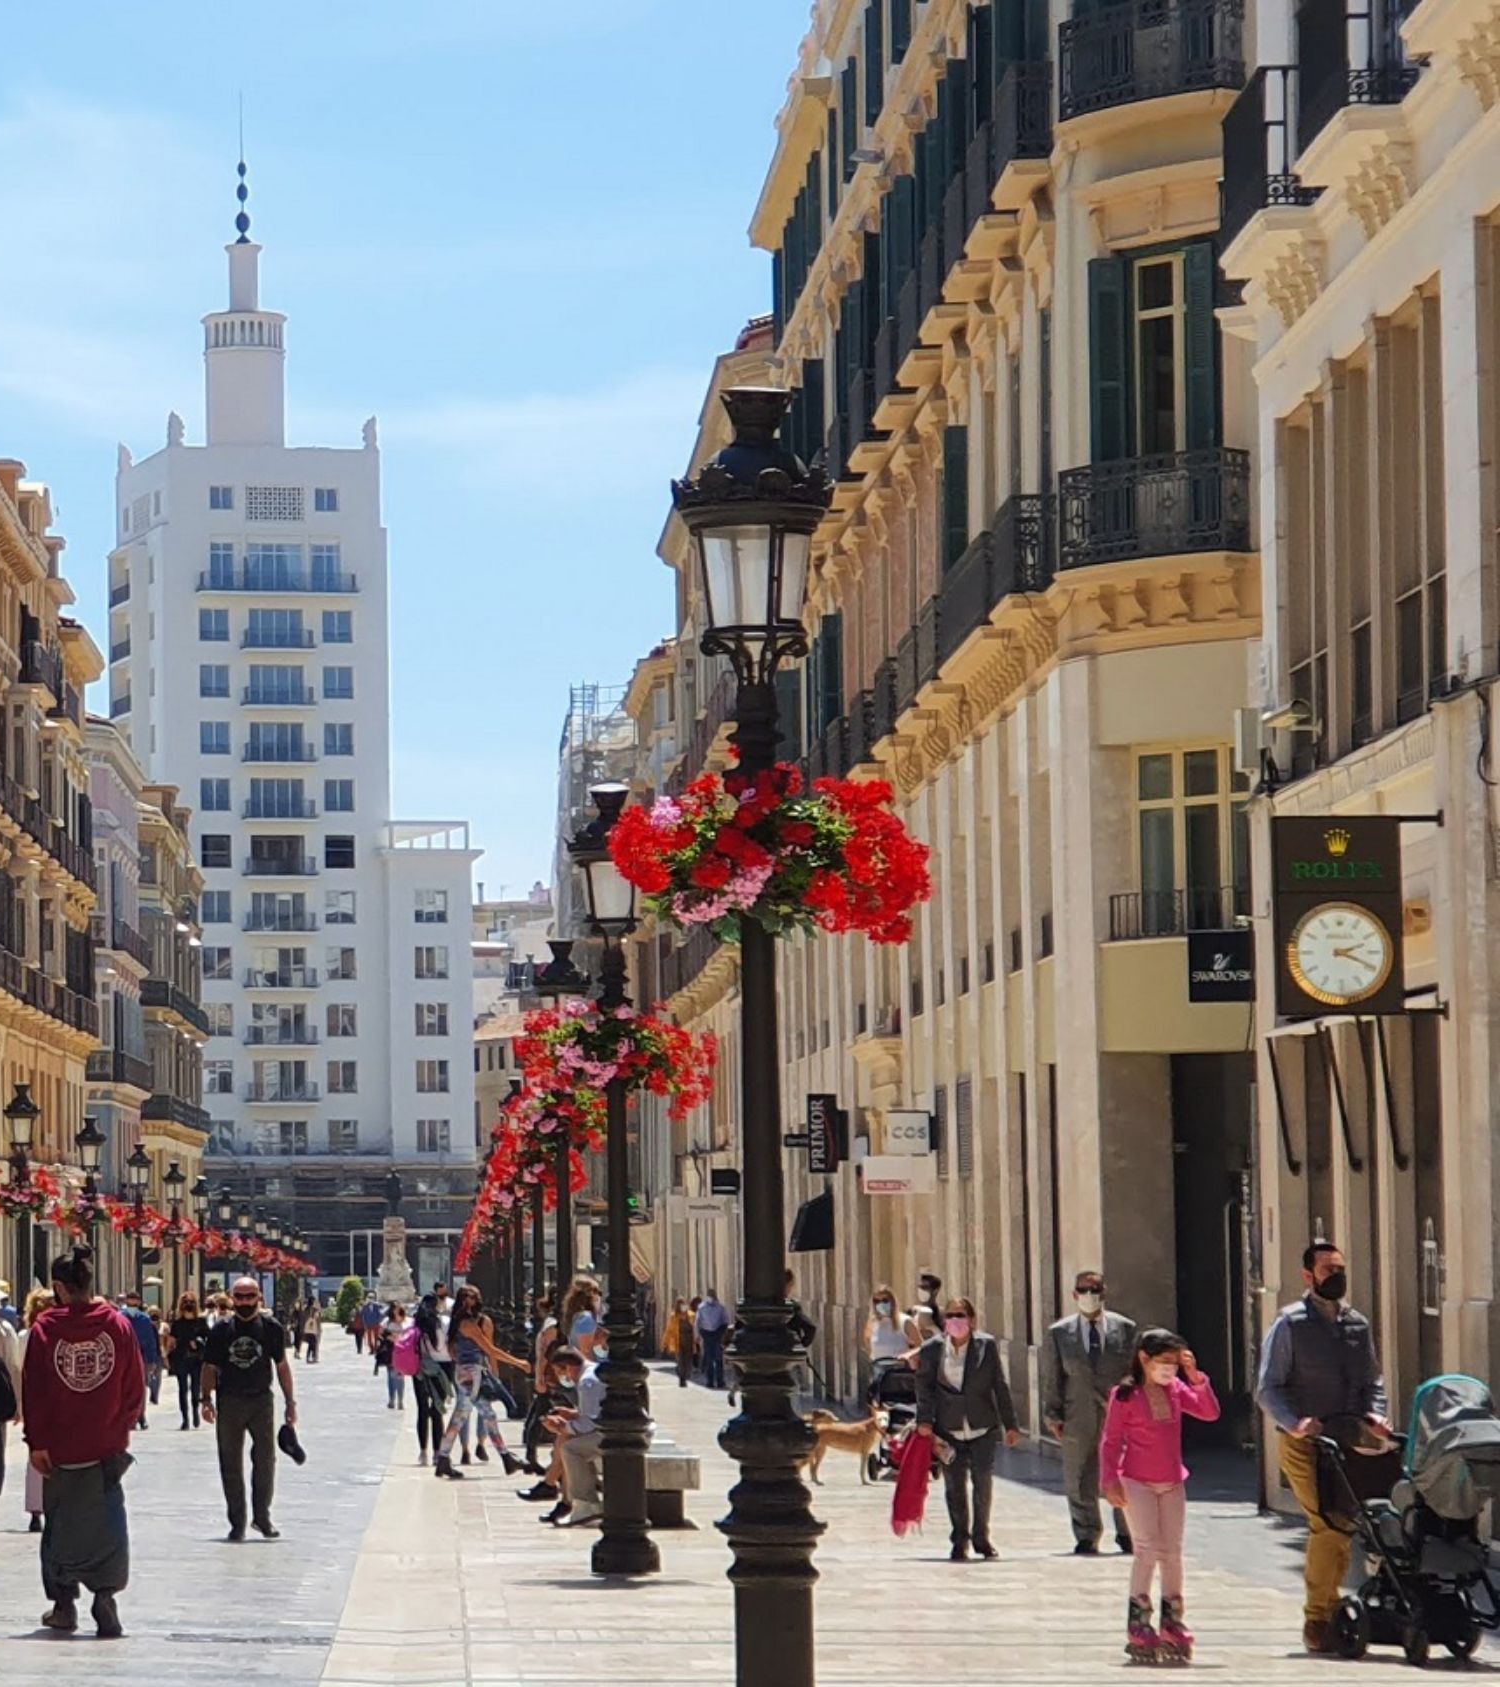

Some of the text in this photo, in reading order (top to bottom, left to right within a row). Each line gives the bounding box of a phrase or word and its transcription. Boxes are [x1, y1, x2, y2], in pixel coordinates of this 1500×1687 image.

[1292, 860, 1383, 879] ROLEX
[811, 1099, 825, 1169] PRIMOR
[892, 1126, 928, 1139] COS
